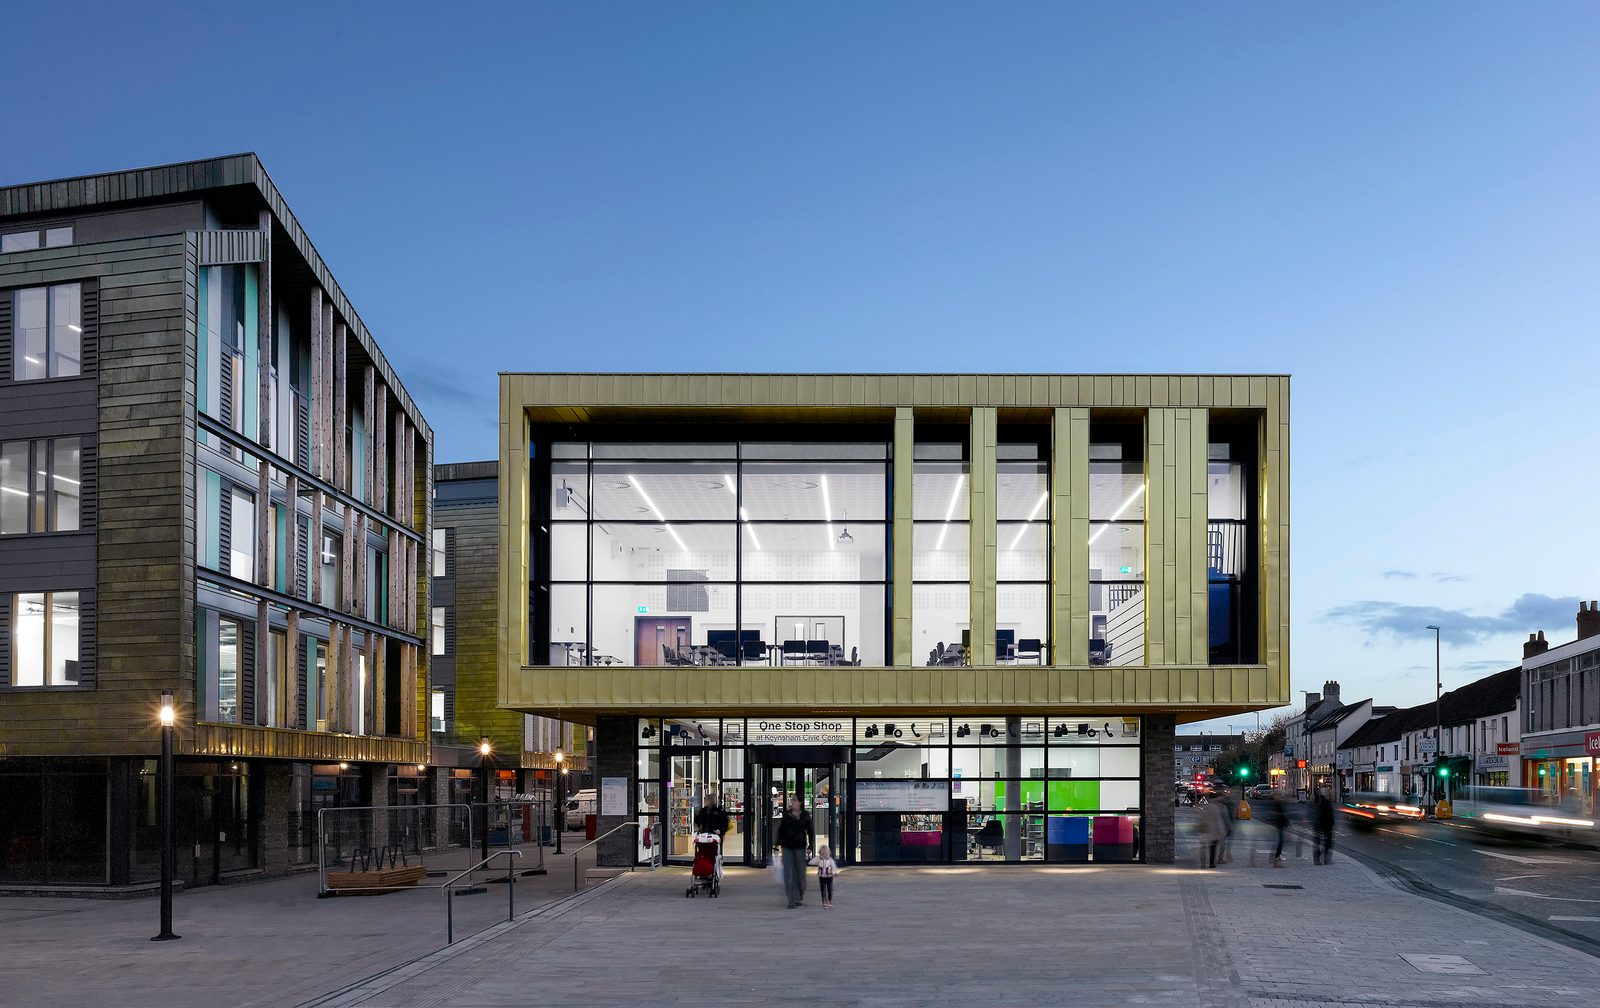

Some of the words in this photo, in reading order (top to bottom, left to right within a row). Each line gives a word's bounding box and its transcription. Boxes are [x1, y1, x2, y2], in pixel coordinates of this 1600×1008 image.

[759, 721, 782, 731] One
[785, 721, 810, 732] Stop
[813, 721, 842, 732] Shop
[764, 734, 801, 742] Keynsham
